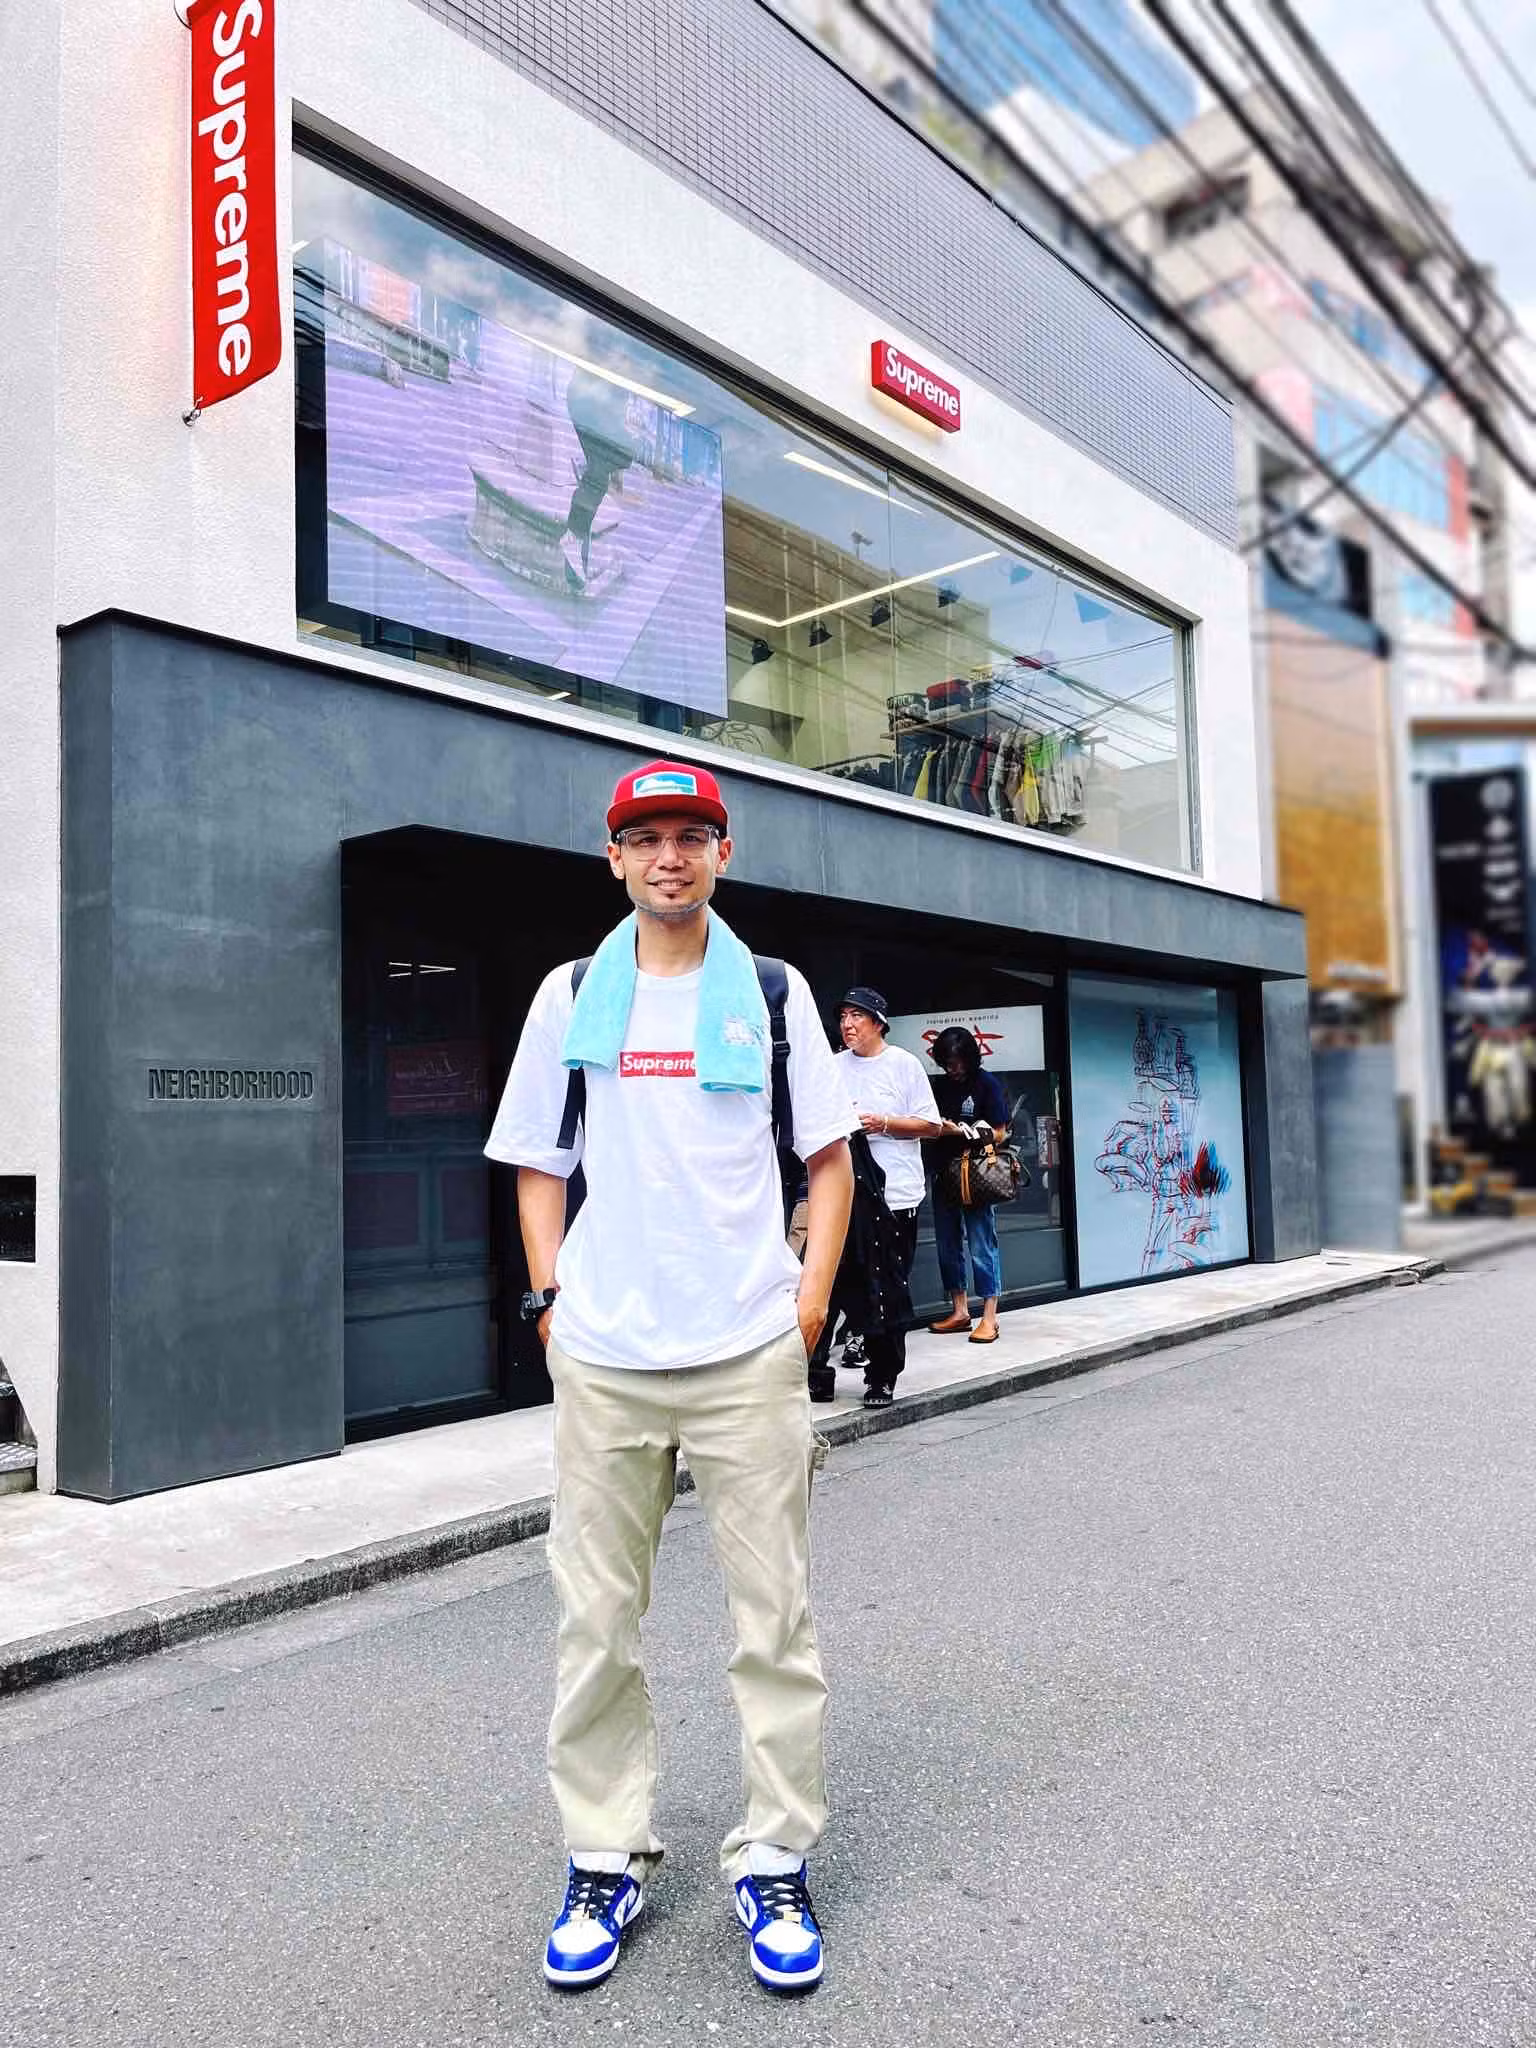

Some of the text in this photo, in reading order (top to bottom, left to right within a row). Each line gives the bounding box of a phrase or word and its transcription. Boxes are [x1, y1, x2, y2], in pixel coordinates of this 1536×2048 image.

[199, 0, 263, 376] Supreme
[886, 347, 959, 416] Supreme
[148, 1069, 313, 1100] NEIGHBORHOOD
